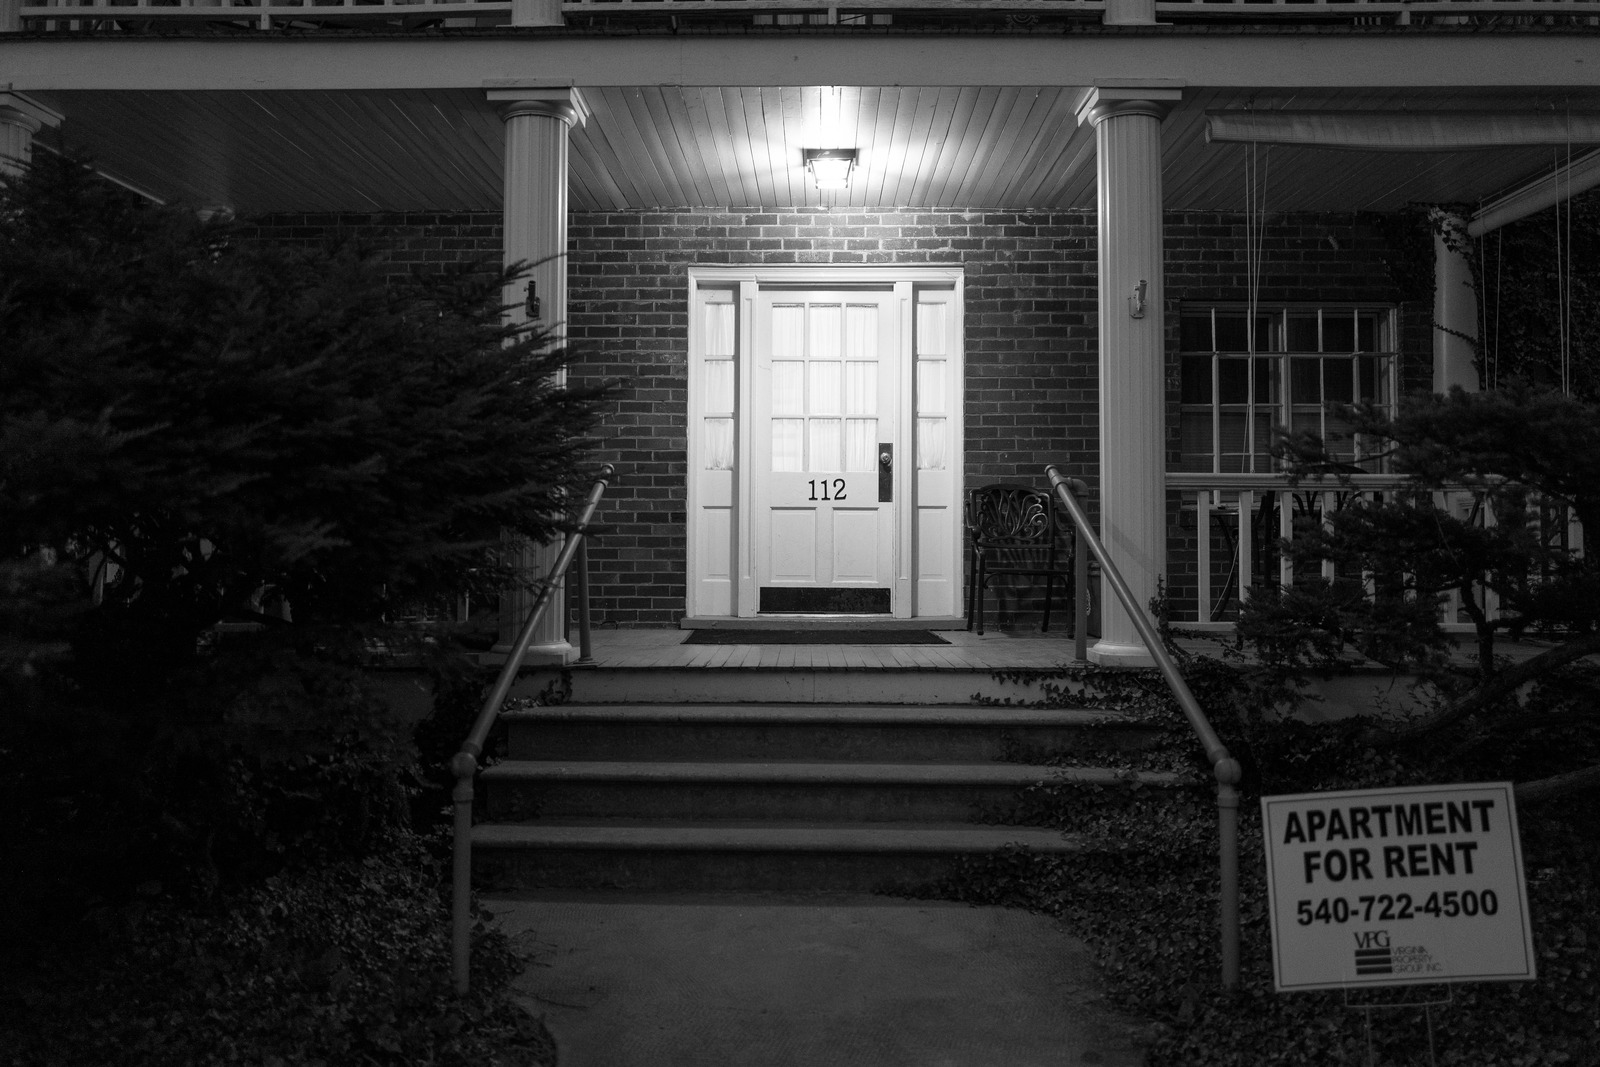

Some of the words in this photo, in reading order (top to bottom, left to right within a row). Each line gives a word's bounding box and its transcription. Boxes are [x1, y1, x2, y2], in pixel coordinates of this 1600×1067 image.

[808, 478, 847, 501] 112
[1283, 800, 1494, 844] APARTMENT
[1303, 848, 1374, 884] FOR
[1384, 841, 1478, 879] RENT
[1297, 889, 1498, 926] 540-722-4500
[1354, 930, 1391, 949] VPG
[1392, 945, 1428, 955] VIRGINIA
[1392, 954, 1433, 964] PROPERTY
